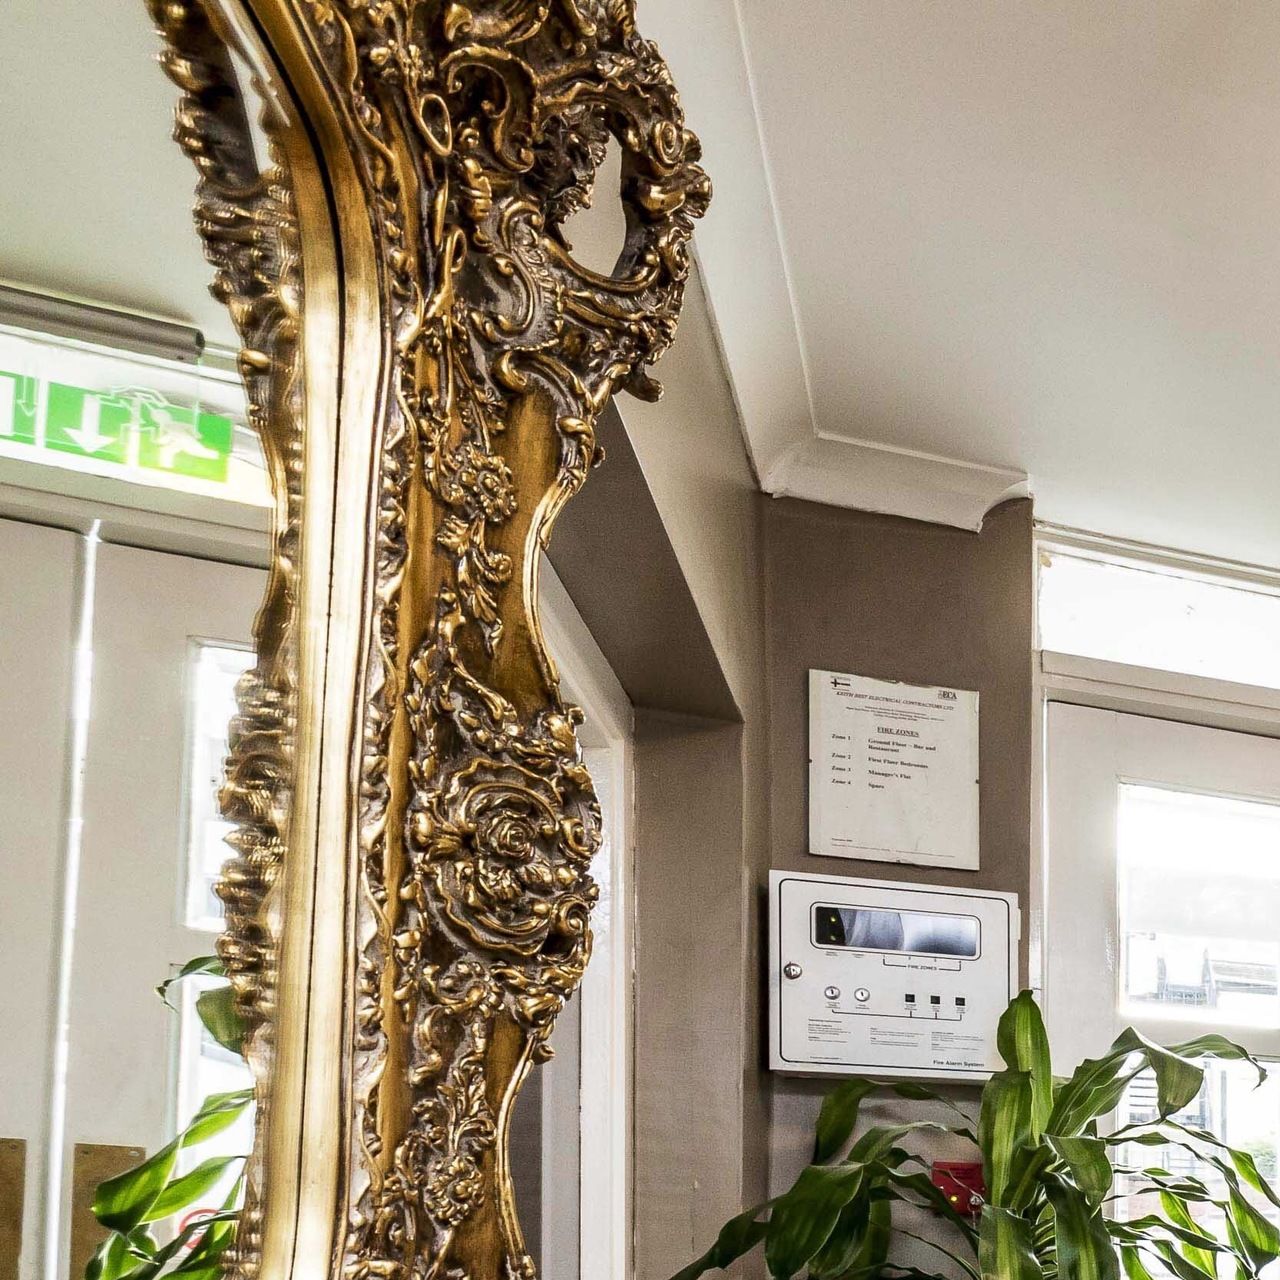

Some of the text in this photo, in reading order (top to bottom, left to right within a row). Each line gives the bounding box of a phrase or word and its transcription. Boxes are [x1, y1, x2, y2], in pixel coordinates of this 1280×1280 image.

[942, 690, 957, 700] ECA
[868, 694, 901, 703] ELECTRICAL
[902, 700, 943, 709] CONTRACTORS
[877, 726, 919, 738] FIRE ZONES
[868, 738, 891, 746] Ground
[868, 744, 900, 753] Restaurant
